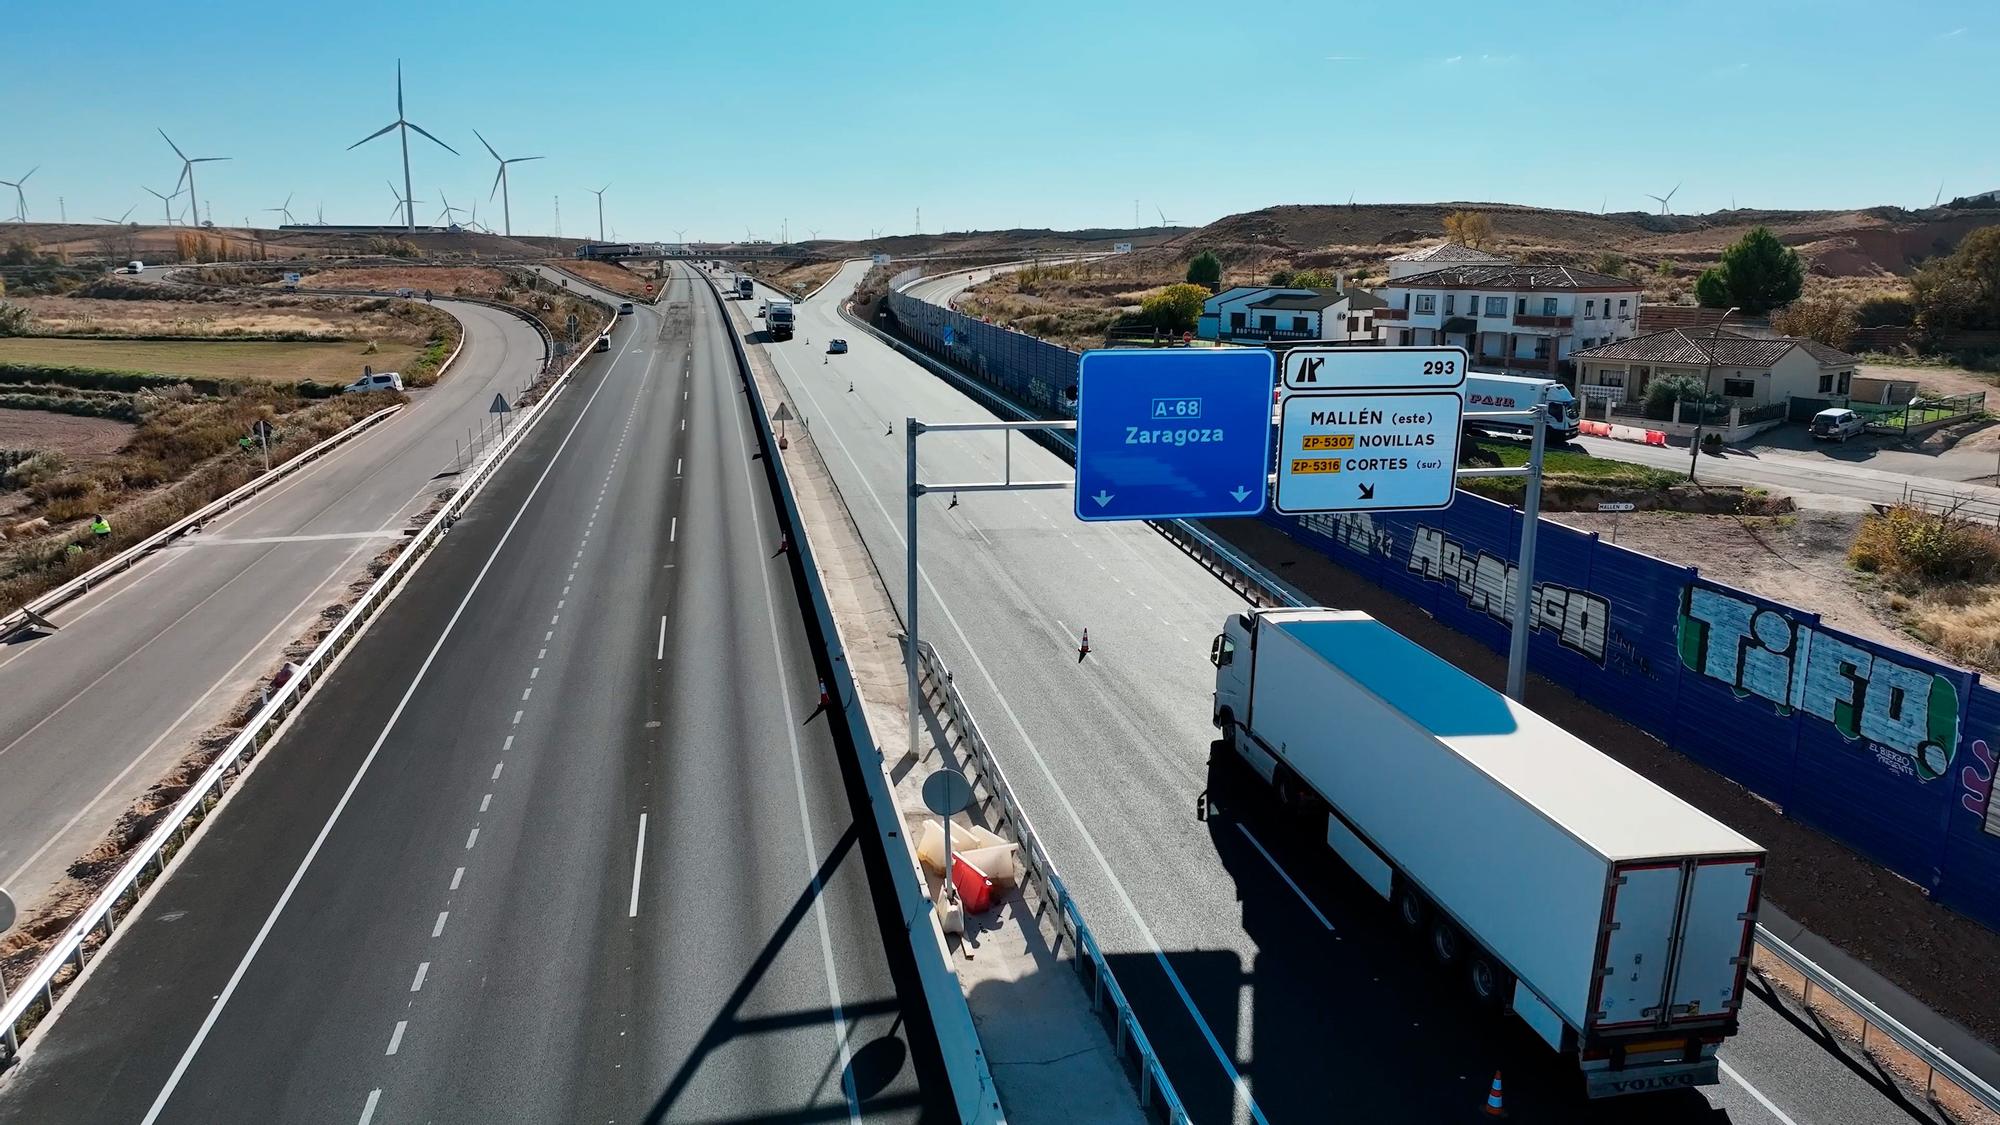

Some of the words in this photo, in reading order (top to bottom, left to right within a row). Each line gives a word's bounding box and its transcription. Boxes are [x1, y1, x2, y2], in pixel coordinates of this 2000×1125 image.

[1423, 360, 1455, 375] 293
[1155, 401, 1199, 416] A-68
[1310, 408, 1383, 425] MALLÉN
[1392, 412, 1433, 425] (este)
[1125, 426, 1224, 447] Zaragoza
[1304, 437, 1354, 448] ZP-5307
[1359, 434, 1435, 447] NOVILLAS
[1293, 461, 1340, 472] ZP-5316
[1346, 458, 1408, 471] CORTES
[1416, 460, 1442, 470] (sur)
[1611, 1073, 1696, 1092] VOLVO
